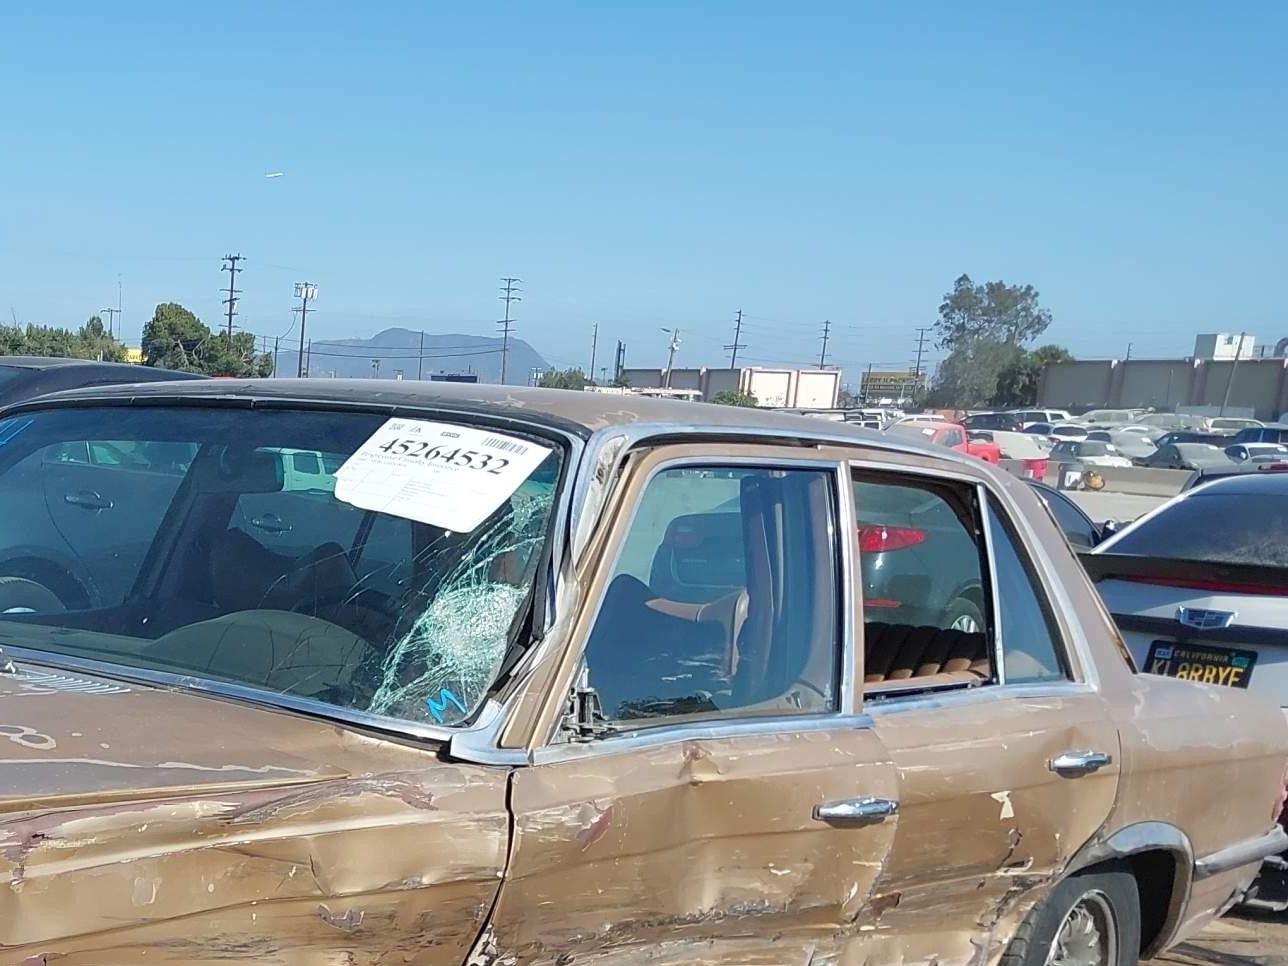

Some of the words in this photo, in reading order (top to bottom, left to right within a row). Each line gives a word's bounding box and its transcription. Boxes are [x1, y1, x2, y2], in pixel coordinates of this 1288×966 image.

[379, 437, 510, 475] 45264532
[1174, 649, 1229, 662] CALIFORNIA
[426, 688, 467, 724] M
